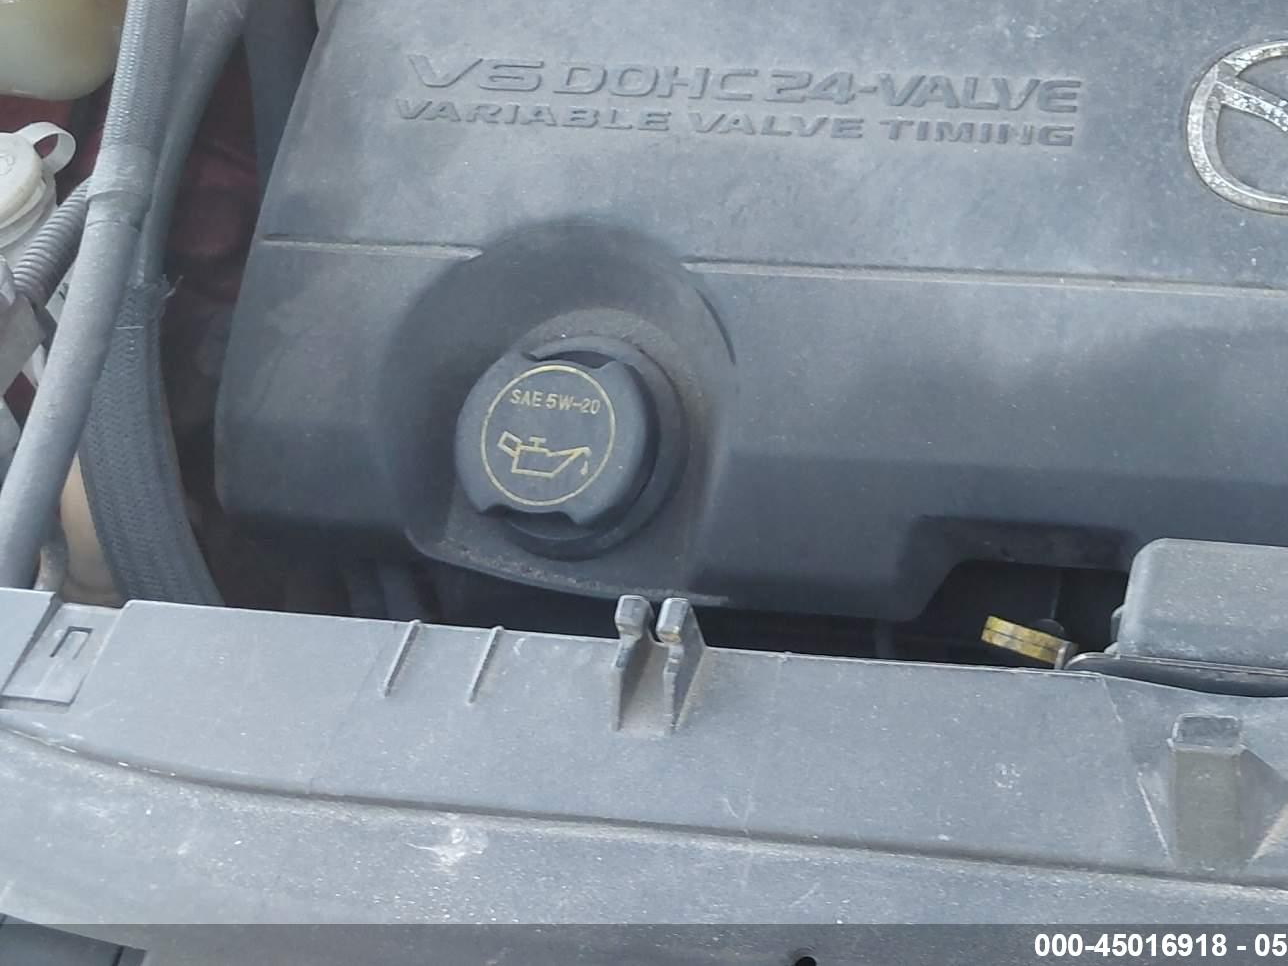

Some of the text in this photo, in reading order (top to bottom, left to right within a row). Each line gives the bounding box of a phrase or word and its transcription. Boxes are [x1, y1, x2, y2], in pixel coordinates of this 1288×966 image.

[406, 53, 1083, 113] V6 DOHC 24-VALVE
[395, 98, 1076, 148] VARIABLE VALVE TIMING
[510, 389, 601, 414] SAE 5W-20
